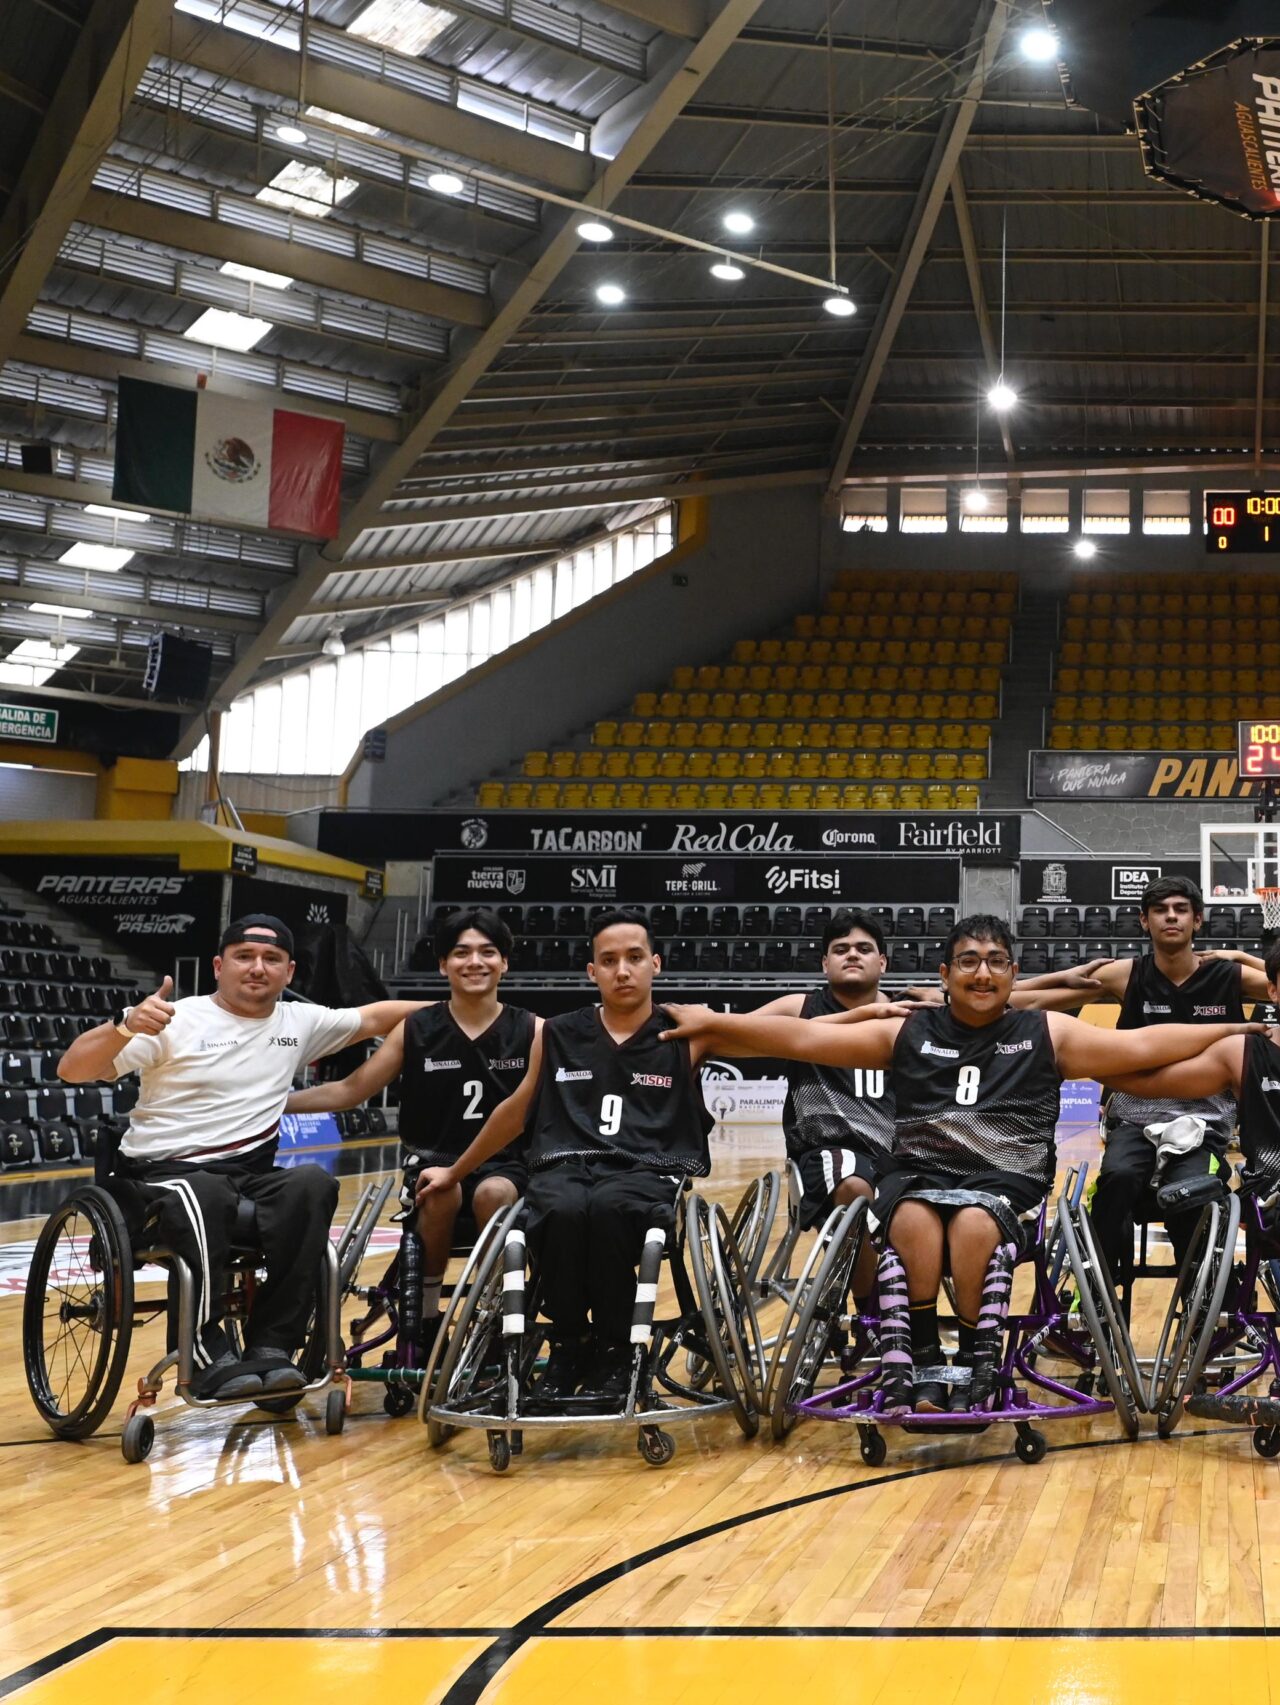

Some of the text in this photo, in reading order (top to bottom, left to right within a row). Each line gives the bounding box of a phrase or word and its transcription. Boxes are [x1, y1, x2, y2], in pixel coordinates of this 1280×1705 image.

[1233, 102, 1266, 191] AGUASCALIENTES
[1214, 507, 1235, 525] 00
[1218, 536, 1227, 549] 0
[0, 708, 47, 724] ALIDA DE
[0, 721, 52, 738] ERGENCIA
[1057, 763, 1111, 782] PANTERA
[1062, 772, 1127, 792] QUE NUNCA
[822, 829, 877, 847] Corona
[898, 822, 1001, 846] Fairfield
[467, 880, 504, 888] nueva
[472, 870, 504, 880] tierra
[571, 867, 617, 888] SMI
[790, 869, 840, 889] Fitsi
[1119, 871, 1149, 883] IDEA
[36, 875, 185, 894] PANTERAS
[57, 895, 159, 905] AGUASCALIENTES
[1202, 1005, 1227, 1016] ISDE
[277, 1036, 298, 1047] ISDE
[498, 1057, 525, 1070] ISDE
[642, 1073, 672, 1088] ISDE
[955, 1065, 980, 1105] 8
[463, 1080, 483, 1120] 2
[599, 1094, 623, 1135] 9
